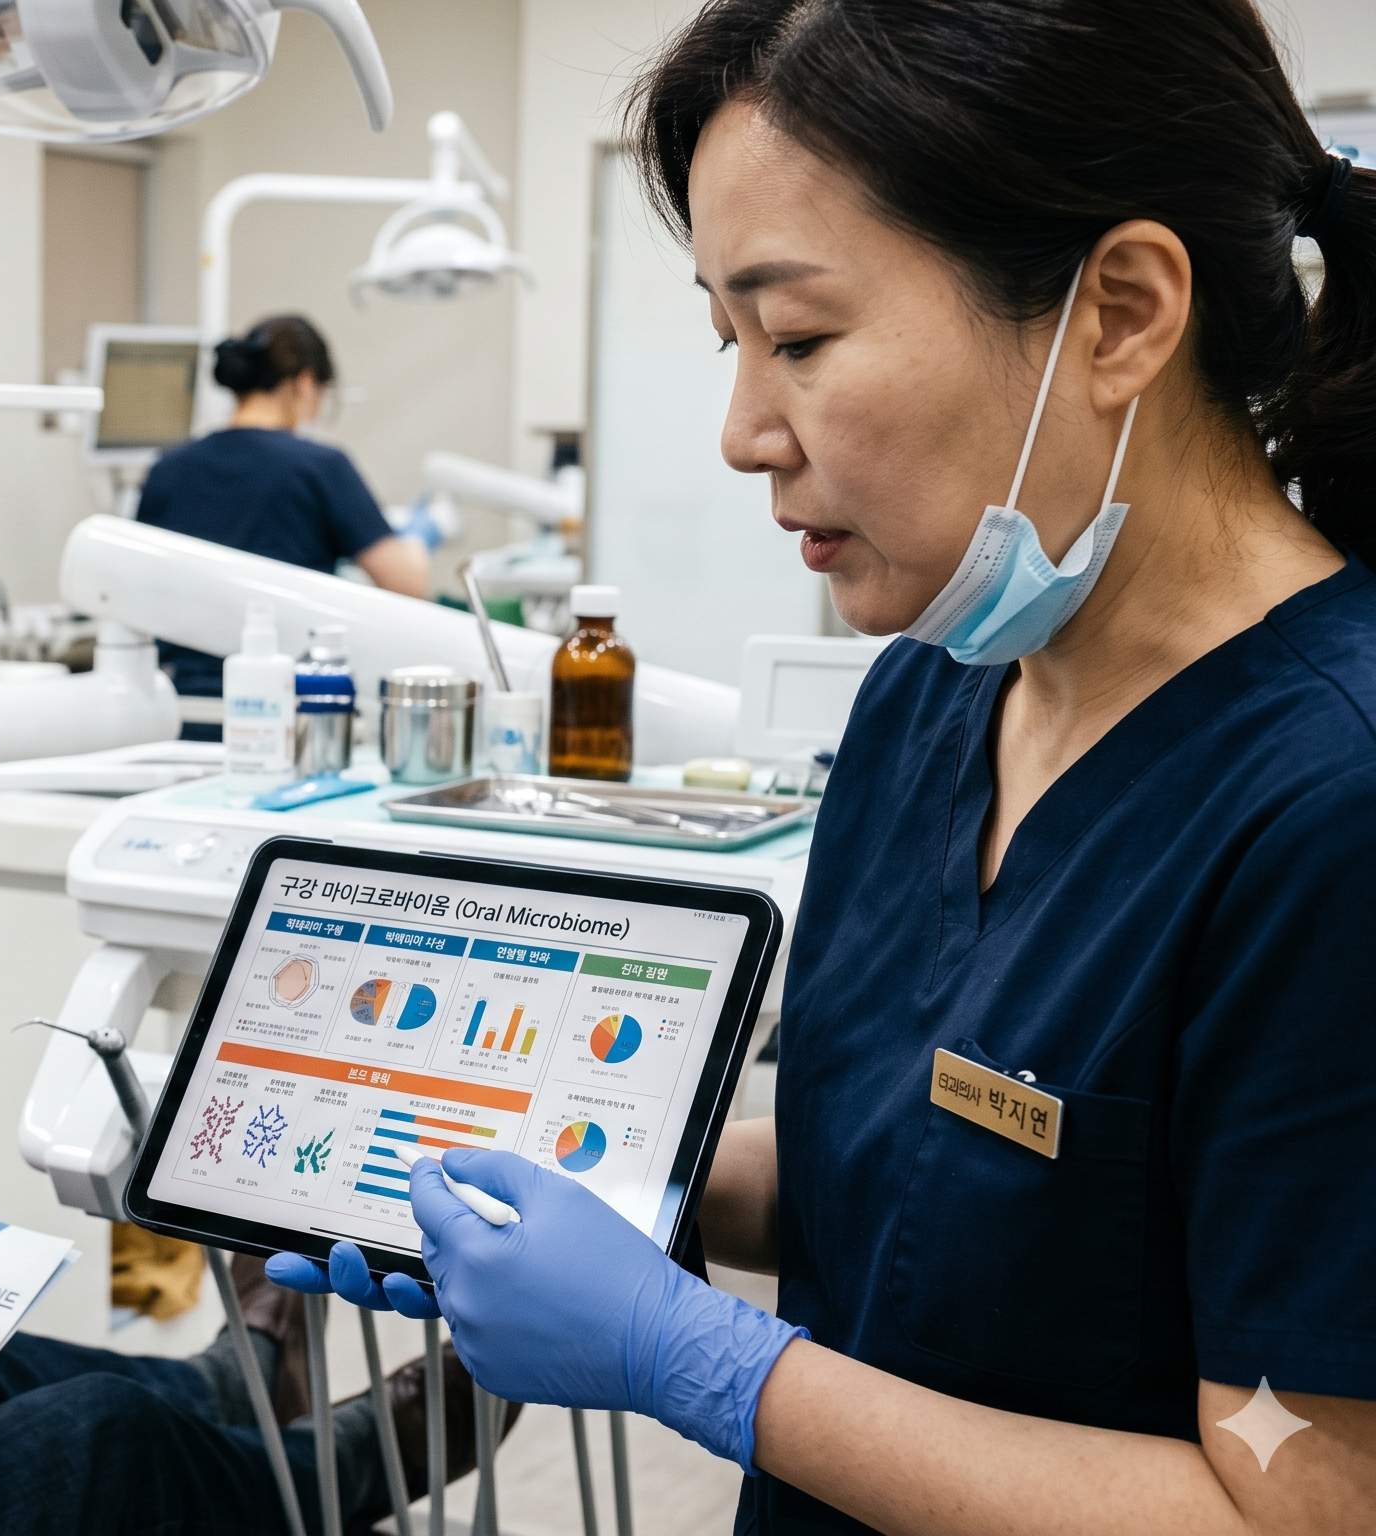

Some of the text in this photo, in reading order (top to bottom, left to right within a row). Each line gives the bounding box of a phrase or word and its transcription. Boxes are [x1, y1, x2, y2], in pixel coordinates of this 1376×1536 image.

[279, 876, 631, 941] 구강 마이크로바이옴 (Oral Microbiome)
[988, 1087, 1049, 1140] 박지연
